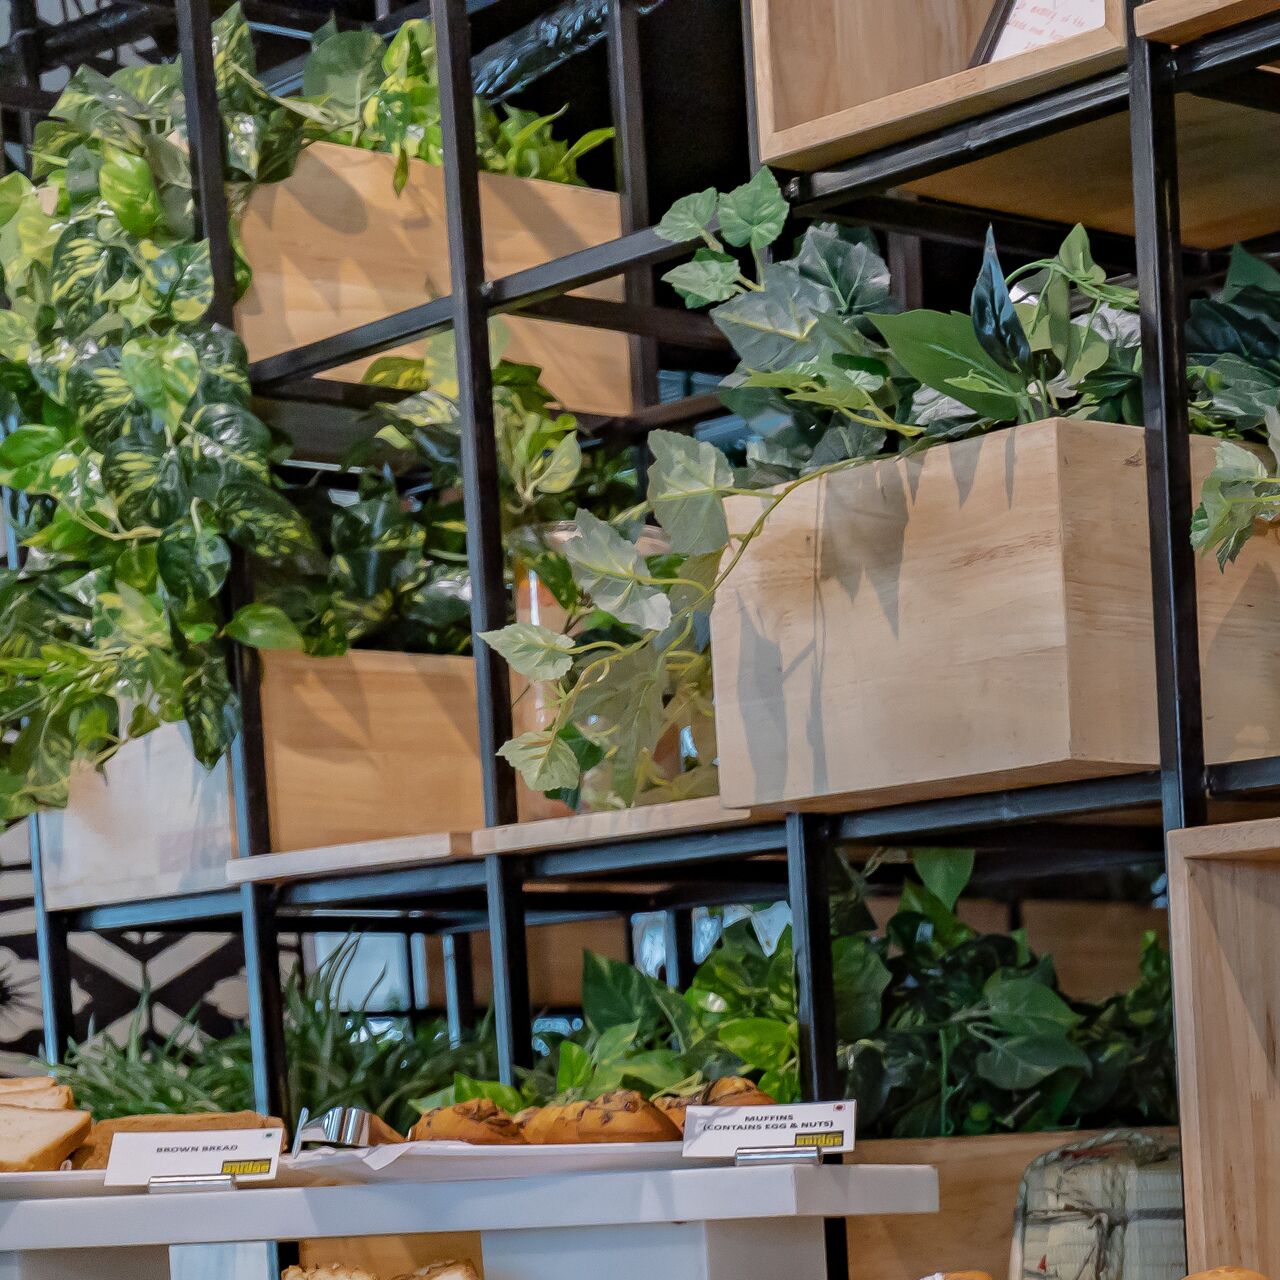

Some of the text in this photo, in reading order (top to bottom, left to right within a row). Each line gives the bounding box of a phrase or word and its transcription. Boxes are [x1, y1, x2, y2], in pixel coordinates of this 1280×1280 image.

[745, 1114, 793, 1122] MUFFINS
[703, 1124, 762, 1132] (CONTAINS
[801, 1120, 833, 1128] NUTS)
[202, 1144, 238, 1152] BREAD
